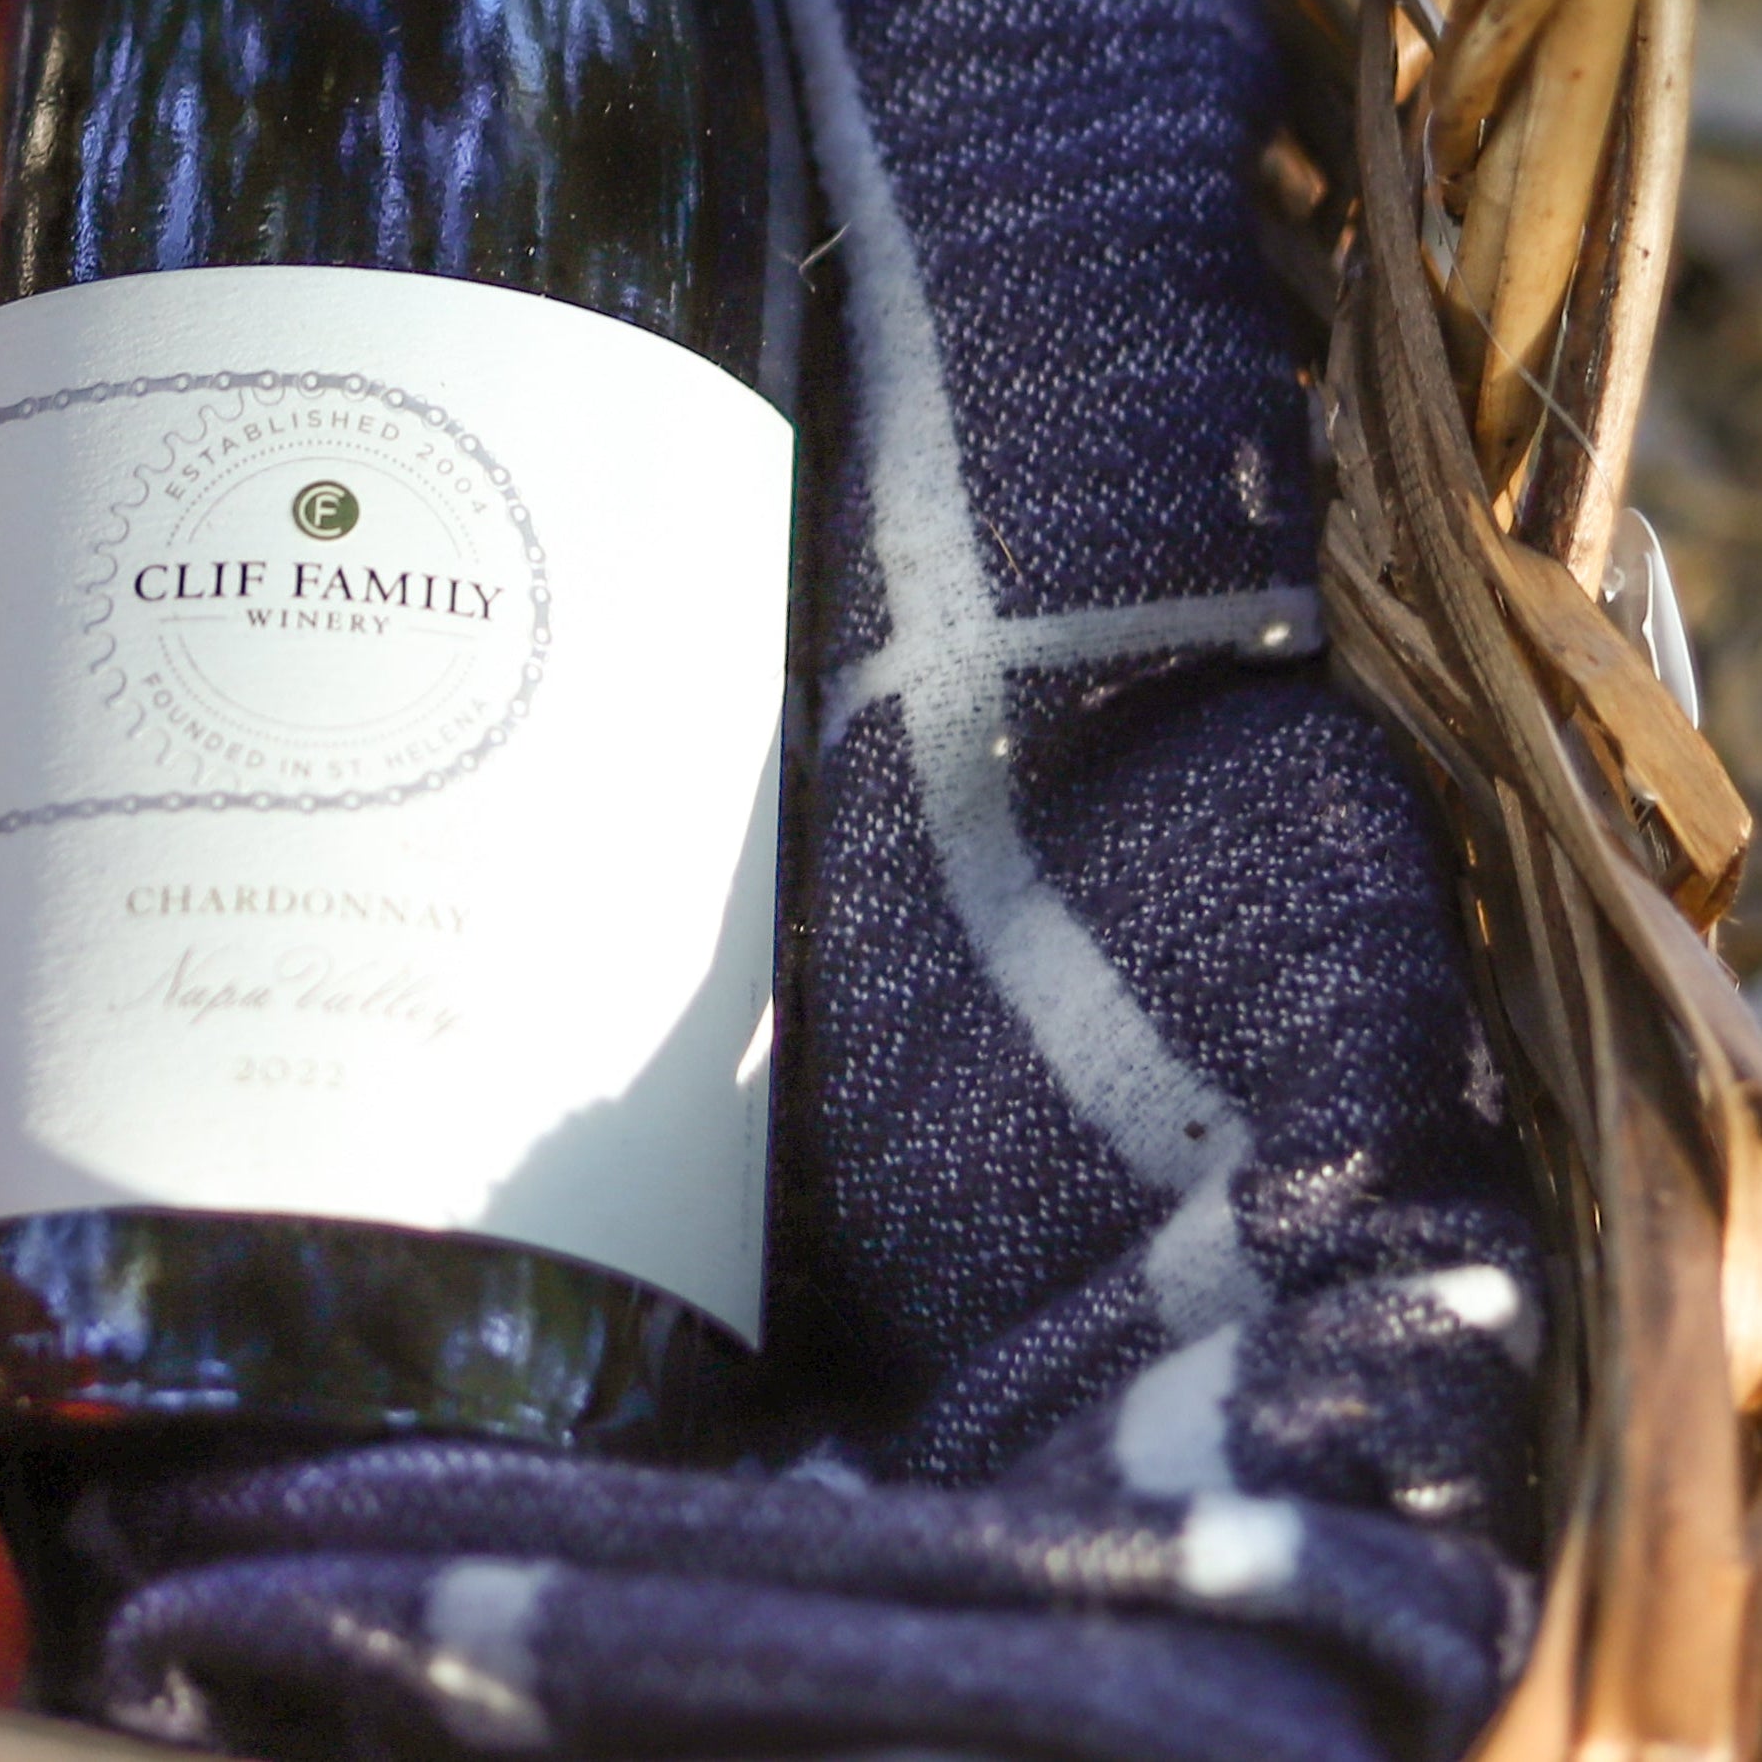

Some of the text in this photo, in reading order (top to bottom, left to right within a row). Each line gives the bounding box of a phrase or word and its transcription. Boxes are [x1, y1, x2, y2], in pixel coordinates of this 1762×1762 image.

[166, 408, 488, 516] ESTABLISHED 2004
[133, 560, 504, 622] CLIF FAMILY
[246, 608, 391, 636] WINERY
[140, 670, 266, 772] FOUNDED
[279, 756, 312, 780] IN
[384, 695, 490, 772] HELENA
[125, 883, 471, 935] CHARDONNAY
[106, 942, 463, 1046] Napa Valley
[231, 1054, 346, 1088] 2022
